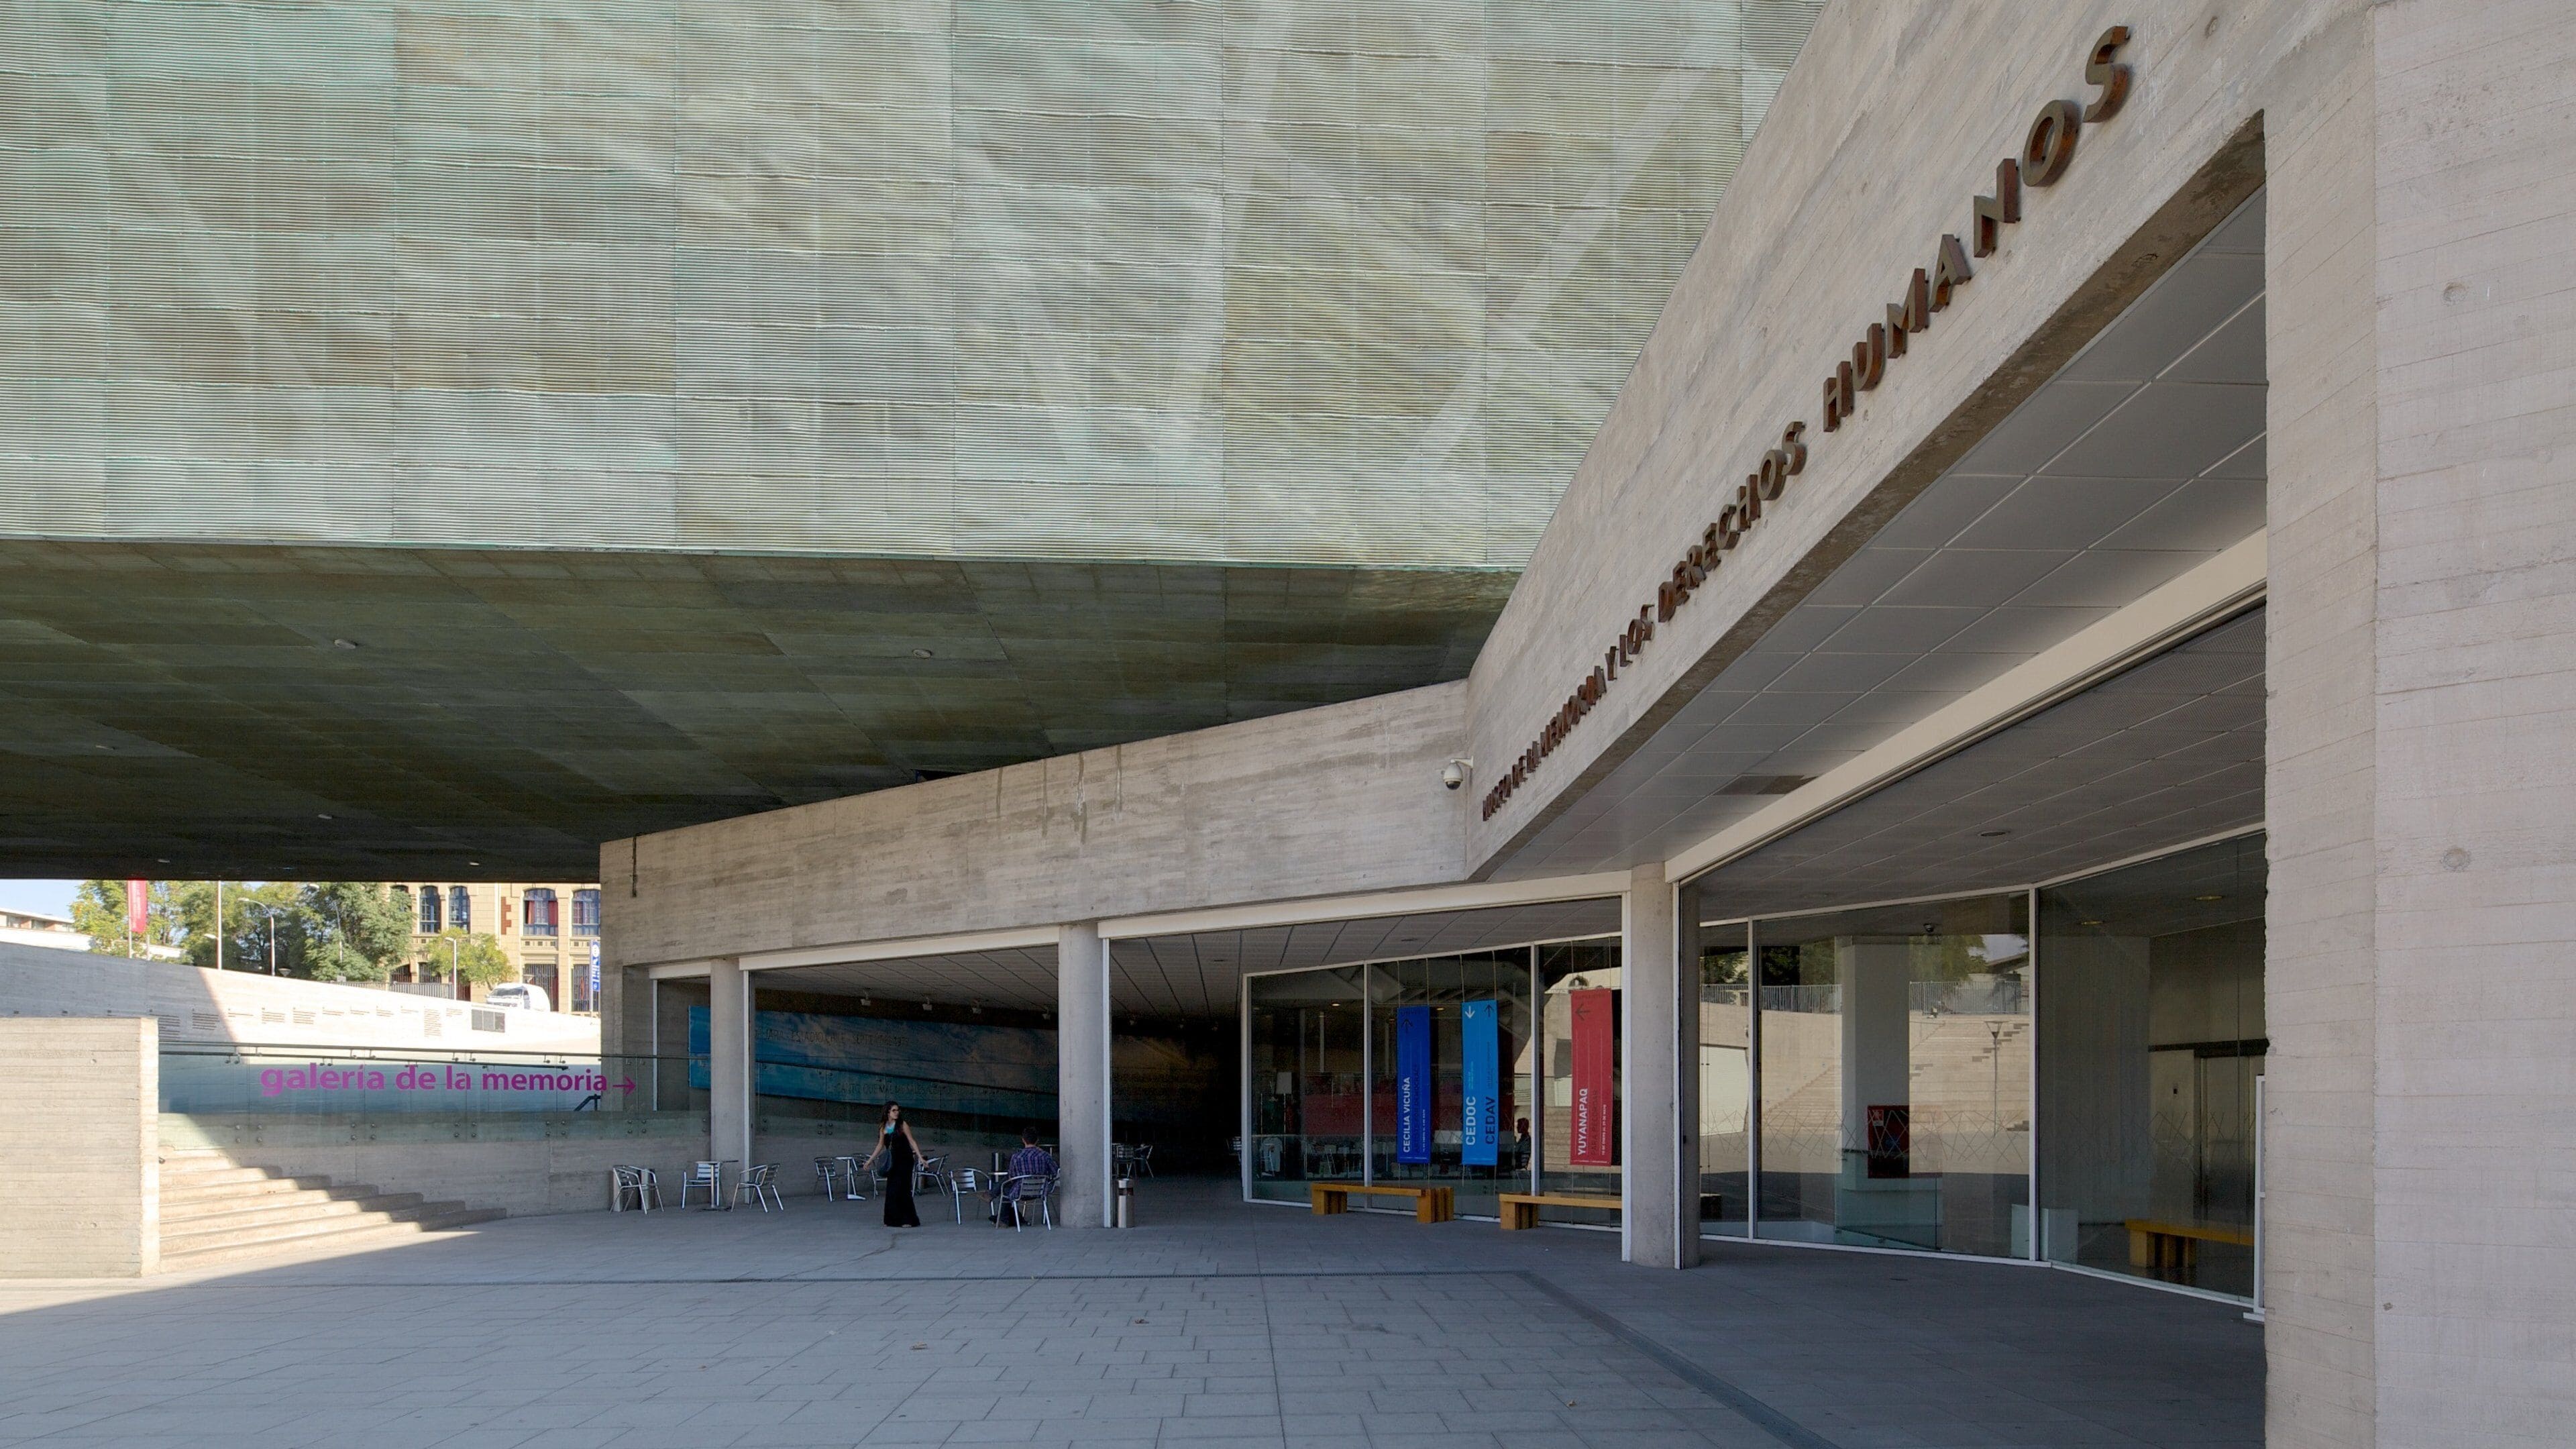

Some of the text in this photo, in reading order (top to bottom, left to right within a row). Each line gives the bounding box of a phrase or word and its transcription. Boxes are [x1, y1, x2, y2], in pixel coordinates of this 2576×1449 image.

[1512, 755, 1528, 789] DE
[1526, 741, 1542, 773] LA
[1540, 665, 1607, 758] MEMORIA
[1605, 646, 1619, 681] Y
[1619, 604, 1655, 667] LOS
[1658, 421, 1807, 623] DERECHOS
[1823, 25, 2133, 433] HUMANOS
[260, 1062, 607, 1097] galería de la memoria
[1402, 1077, 1411, 1153] CECILIA VICUÑA
[1466, 1095, 1476, 1145] CEDOC
[1485, 1095, 1495, 1144] CEDAV
[1577, 1087, 1588, 1156] YUYANAPAQ
